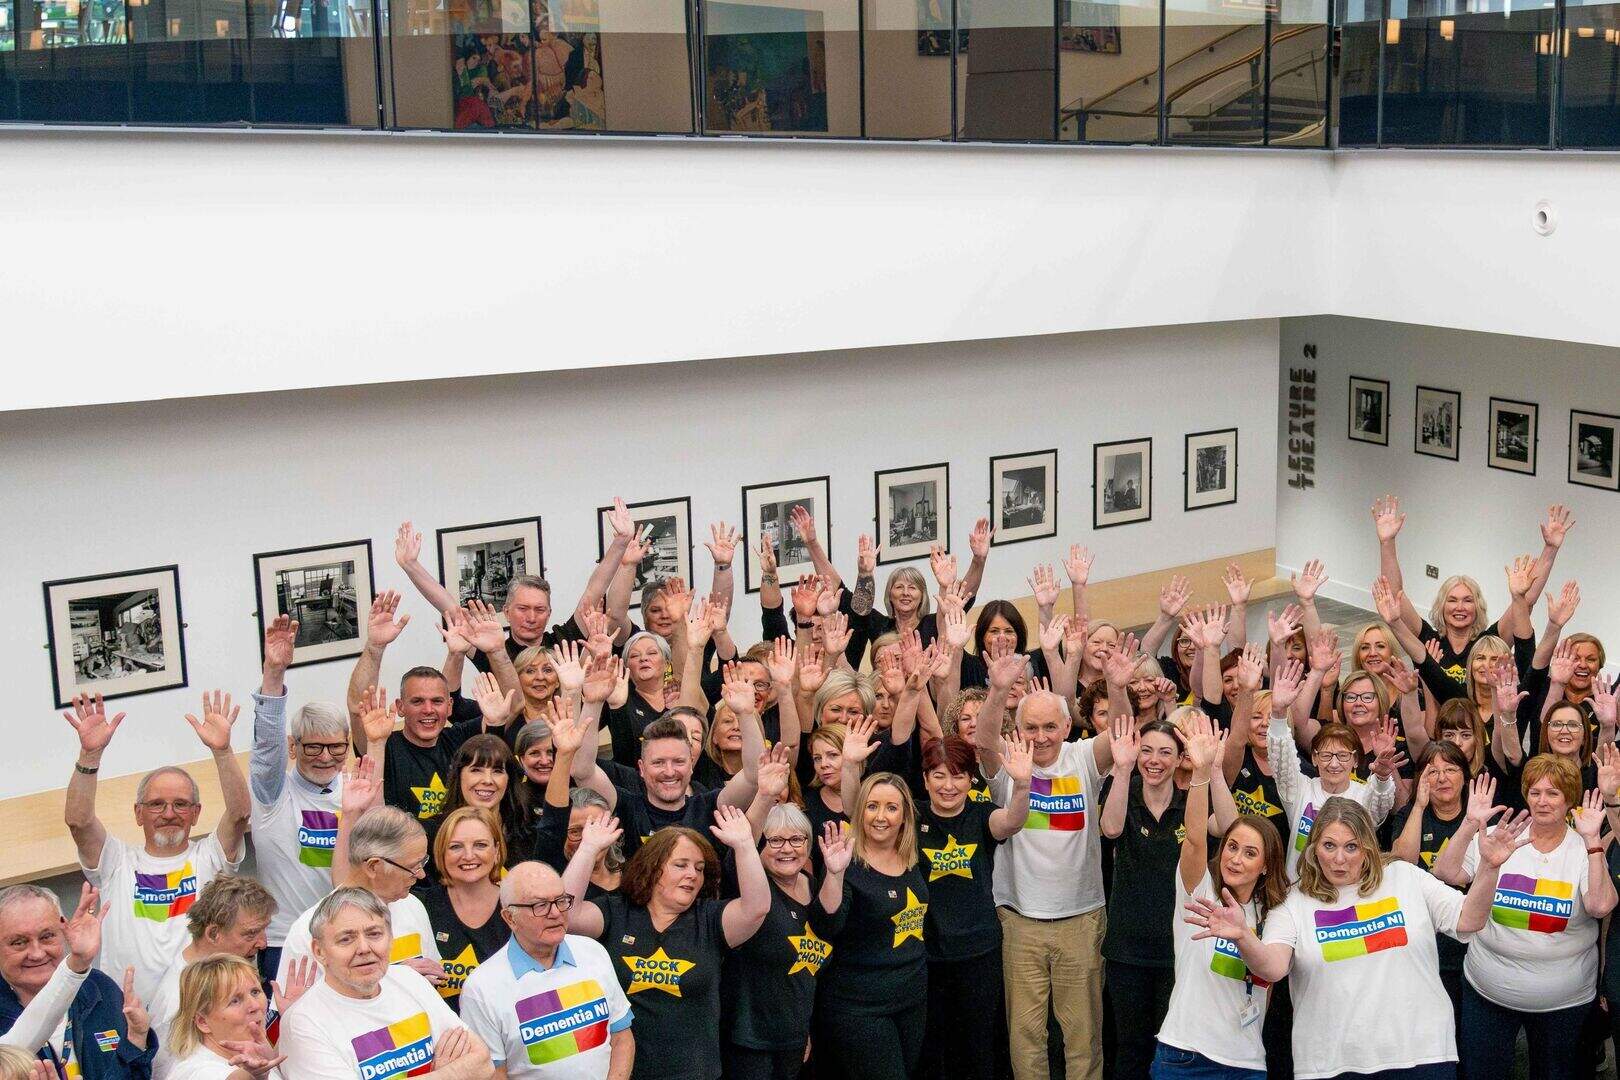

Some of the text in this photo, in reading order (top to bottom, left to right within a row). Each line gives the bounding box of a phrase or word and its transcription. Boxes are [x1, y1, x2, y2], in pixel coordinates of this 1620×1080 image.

[1301, 343, 1317, 490] THEATRE 2
[1288, 368, 1302, 489] LECTURE
[423, 790, 447, 801] ROC
[1030, 798, 1084, 810] mentia NI
[1236, 793, 1271, 814] ROCK
[934, 848, 967, 861] ROCK
[932, 860, 971, 871] CHOIR
[182, 879, 196, 893] NI
[1494, 892, 1571, 914] Dementia NI
[1317, 913, 1404, 941] Dementia NI
[800, 938, 826, 954] ROCK
[635, 958, 680, 972] ROCK
[797, 951, 827, 966] CHOIR
[631, 970, 682, 985] CHOIR
[521, 1001, 609, 1041] Dementia NI
[361, 1047, 427, 1080] Dementia
